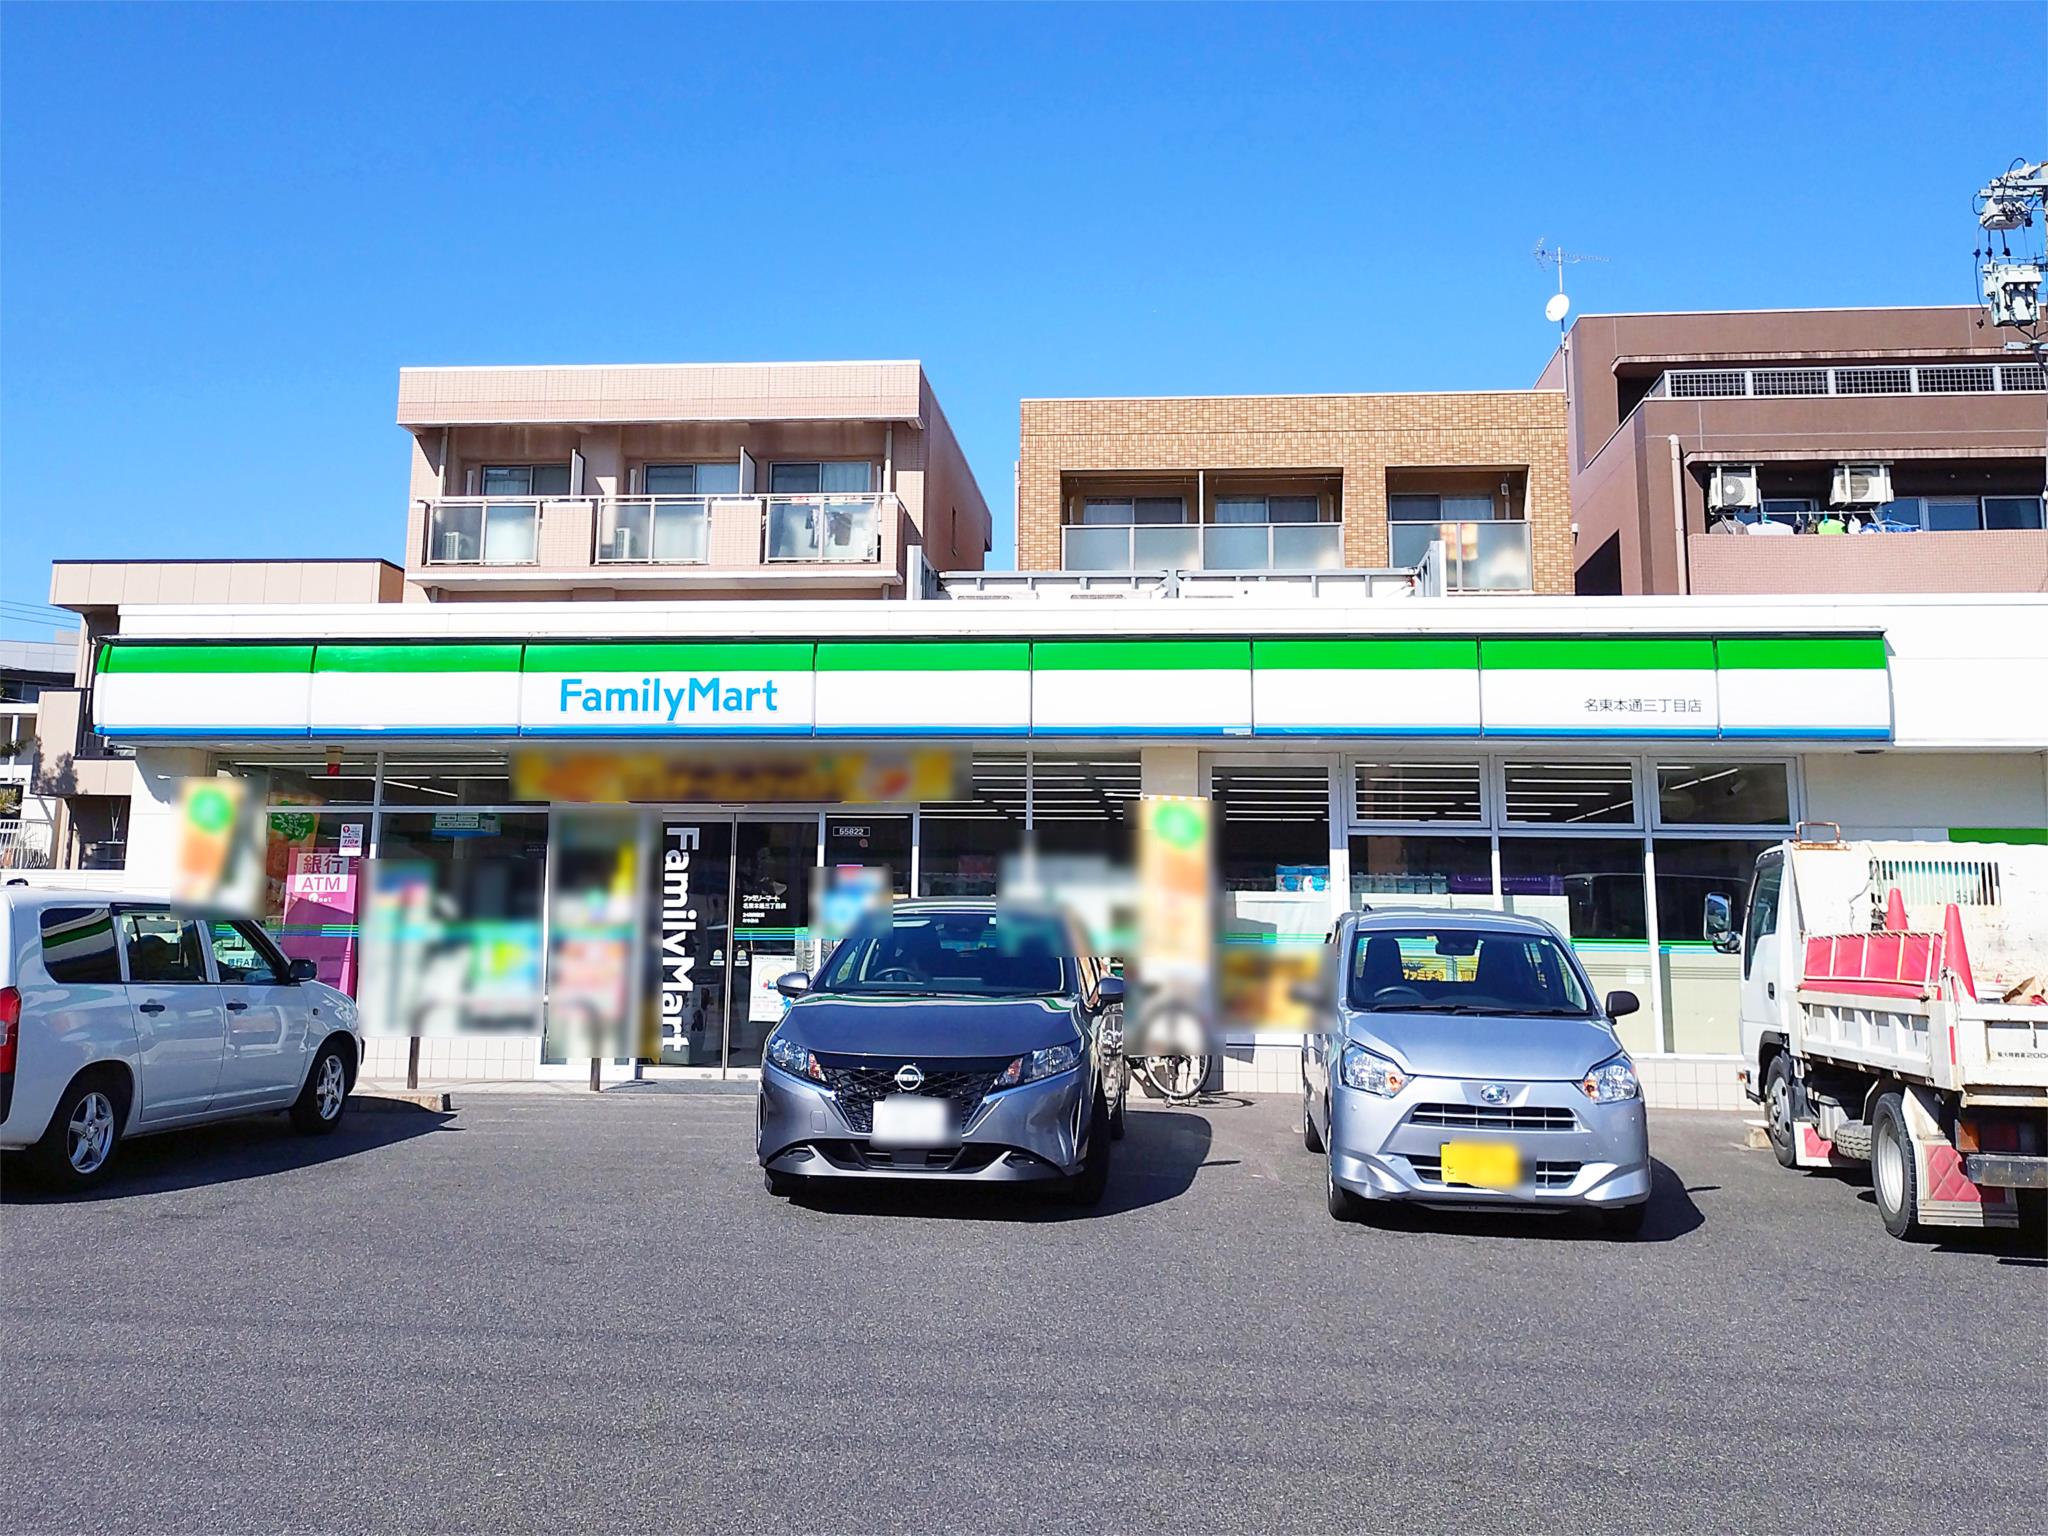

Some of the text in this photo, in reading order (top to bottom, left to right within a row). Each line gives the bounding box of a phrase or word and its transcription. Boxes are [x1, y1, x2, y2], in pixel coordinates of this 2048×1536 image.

[560, 677, 778, 722] FamilyMart
[1584, 698, 1702, 713] 名東本通三丁目店
[839, 827, 864, 836] 55822
[303, 854, 343, 874] 銀行
[302, 877, 341, 891] ATM
[662, 827, 700, 1052] FamilyMart
